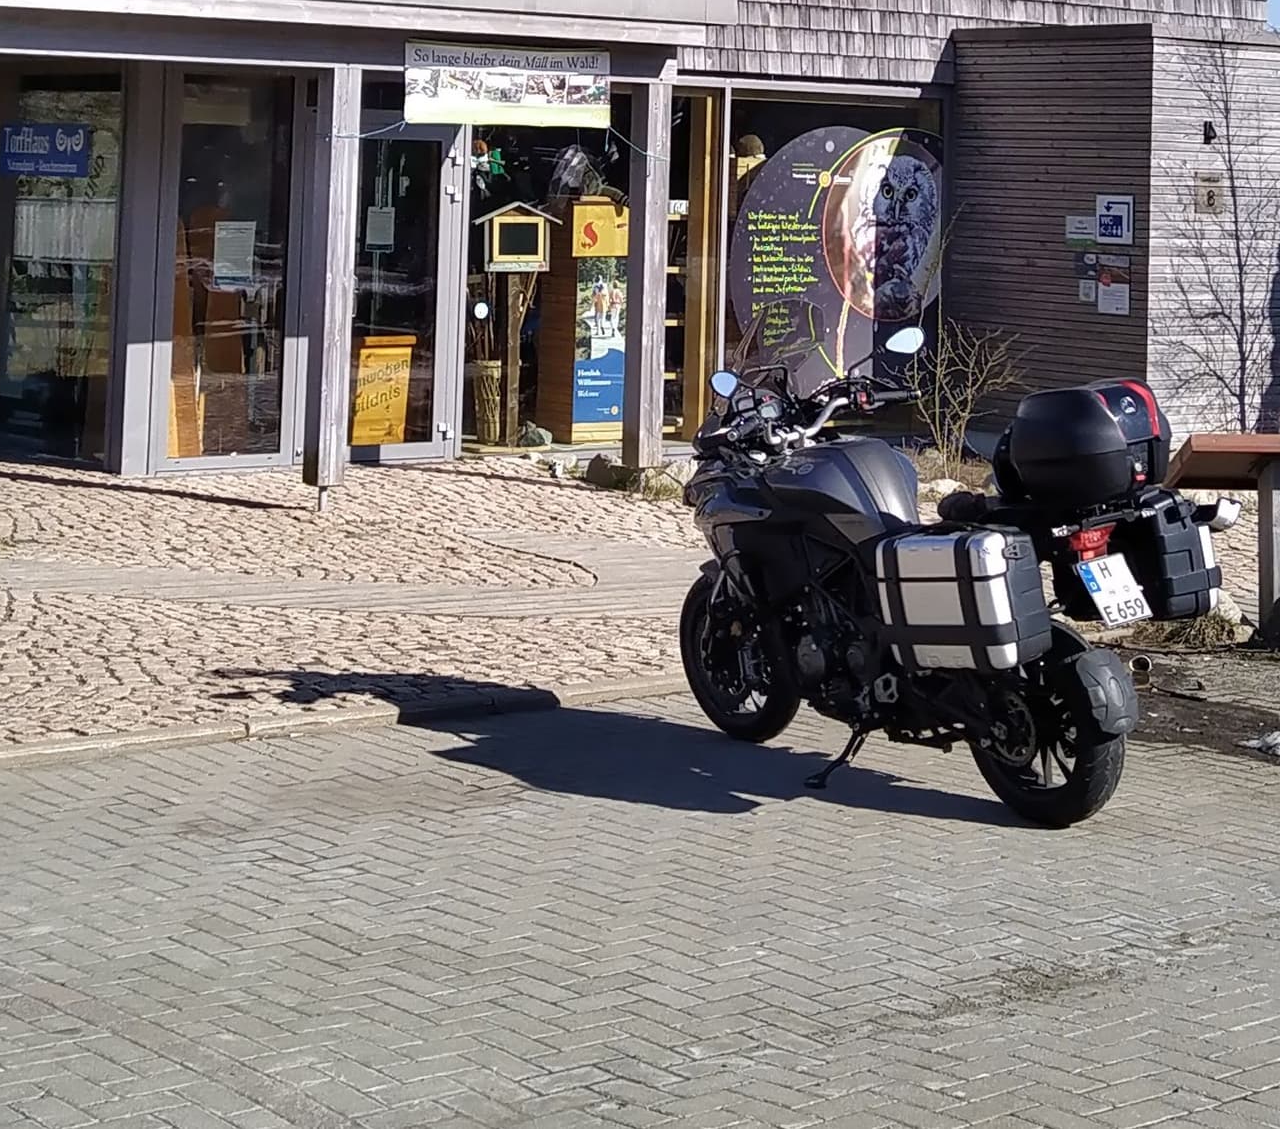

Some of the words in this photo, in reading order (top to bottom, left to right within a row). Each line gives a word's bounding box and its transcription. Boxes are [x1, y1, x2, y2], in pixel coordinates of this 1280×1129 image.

[413, 49, 429, 62] So
[432, 50, 460, 67] lange
[463, 52, 496, 66] bleibt
[498, 55, 520, 68] dein
[523, 55, 549, 69] Müll
[550, 57, 563, 69] im
[566, 56, 599, 70] Wald!
[1097, 561, 1112, 579] H
[1103, 605, 1119, 623] E
[1117, 598, 1144, 619] 659
